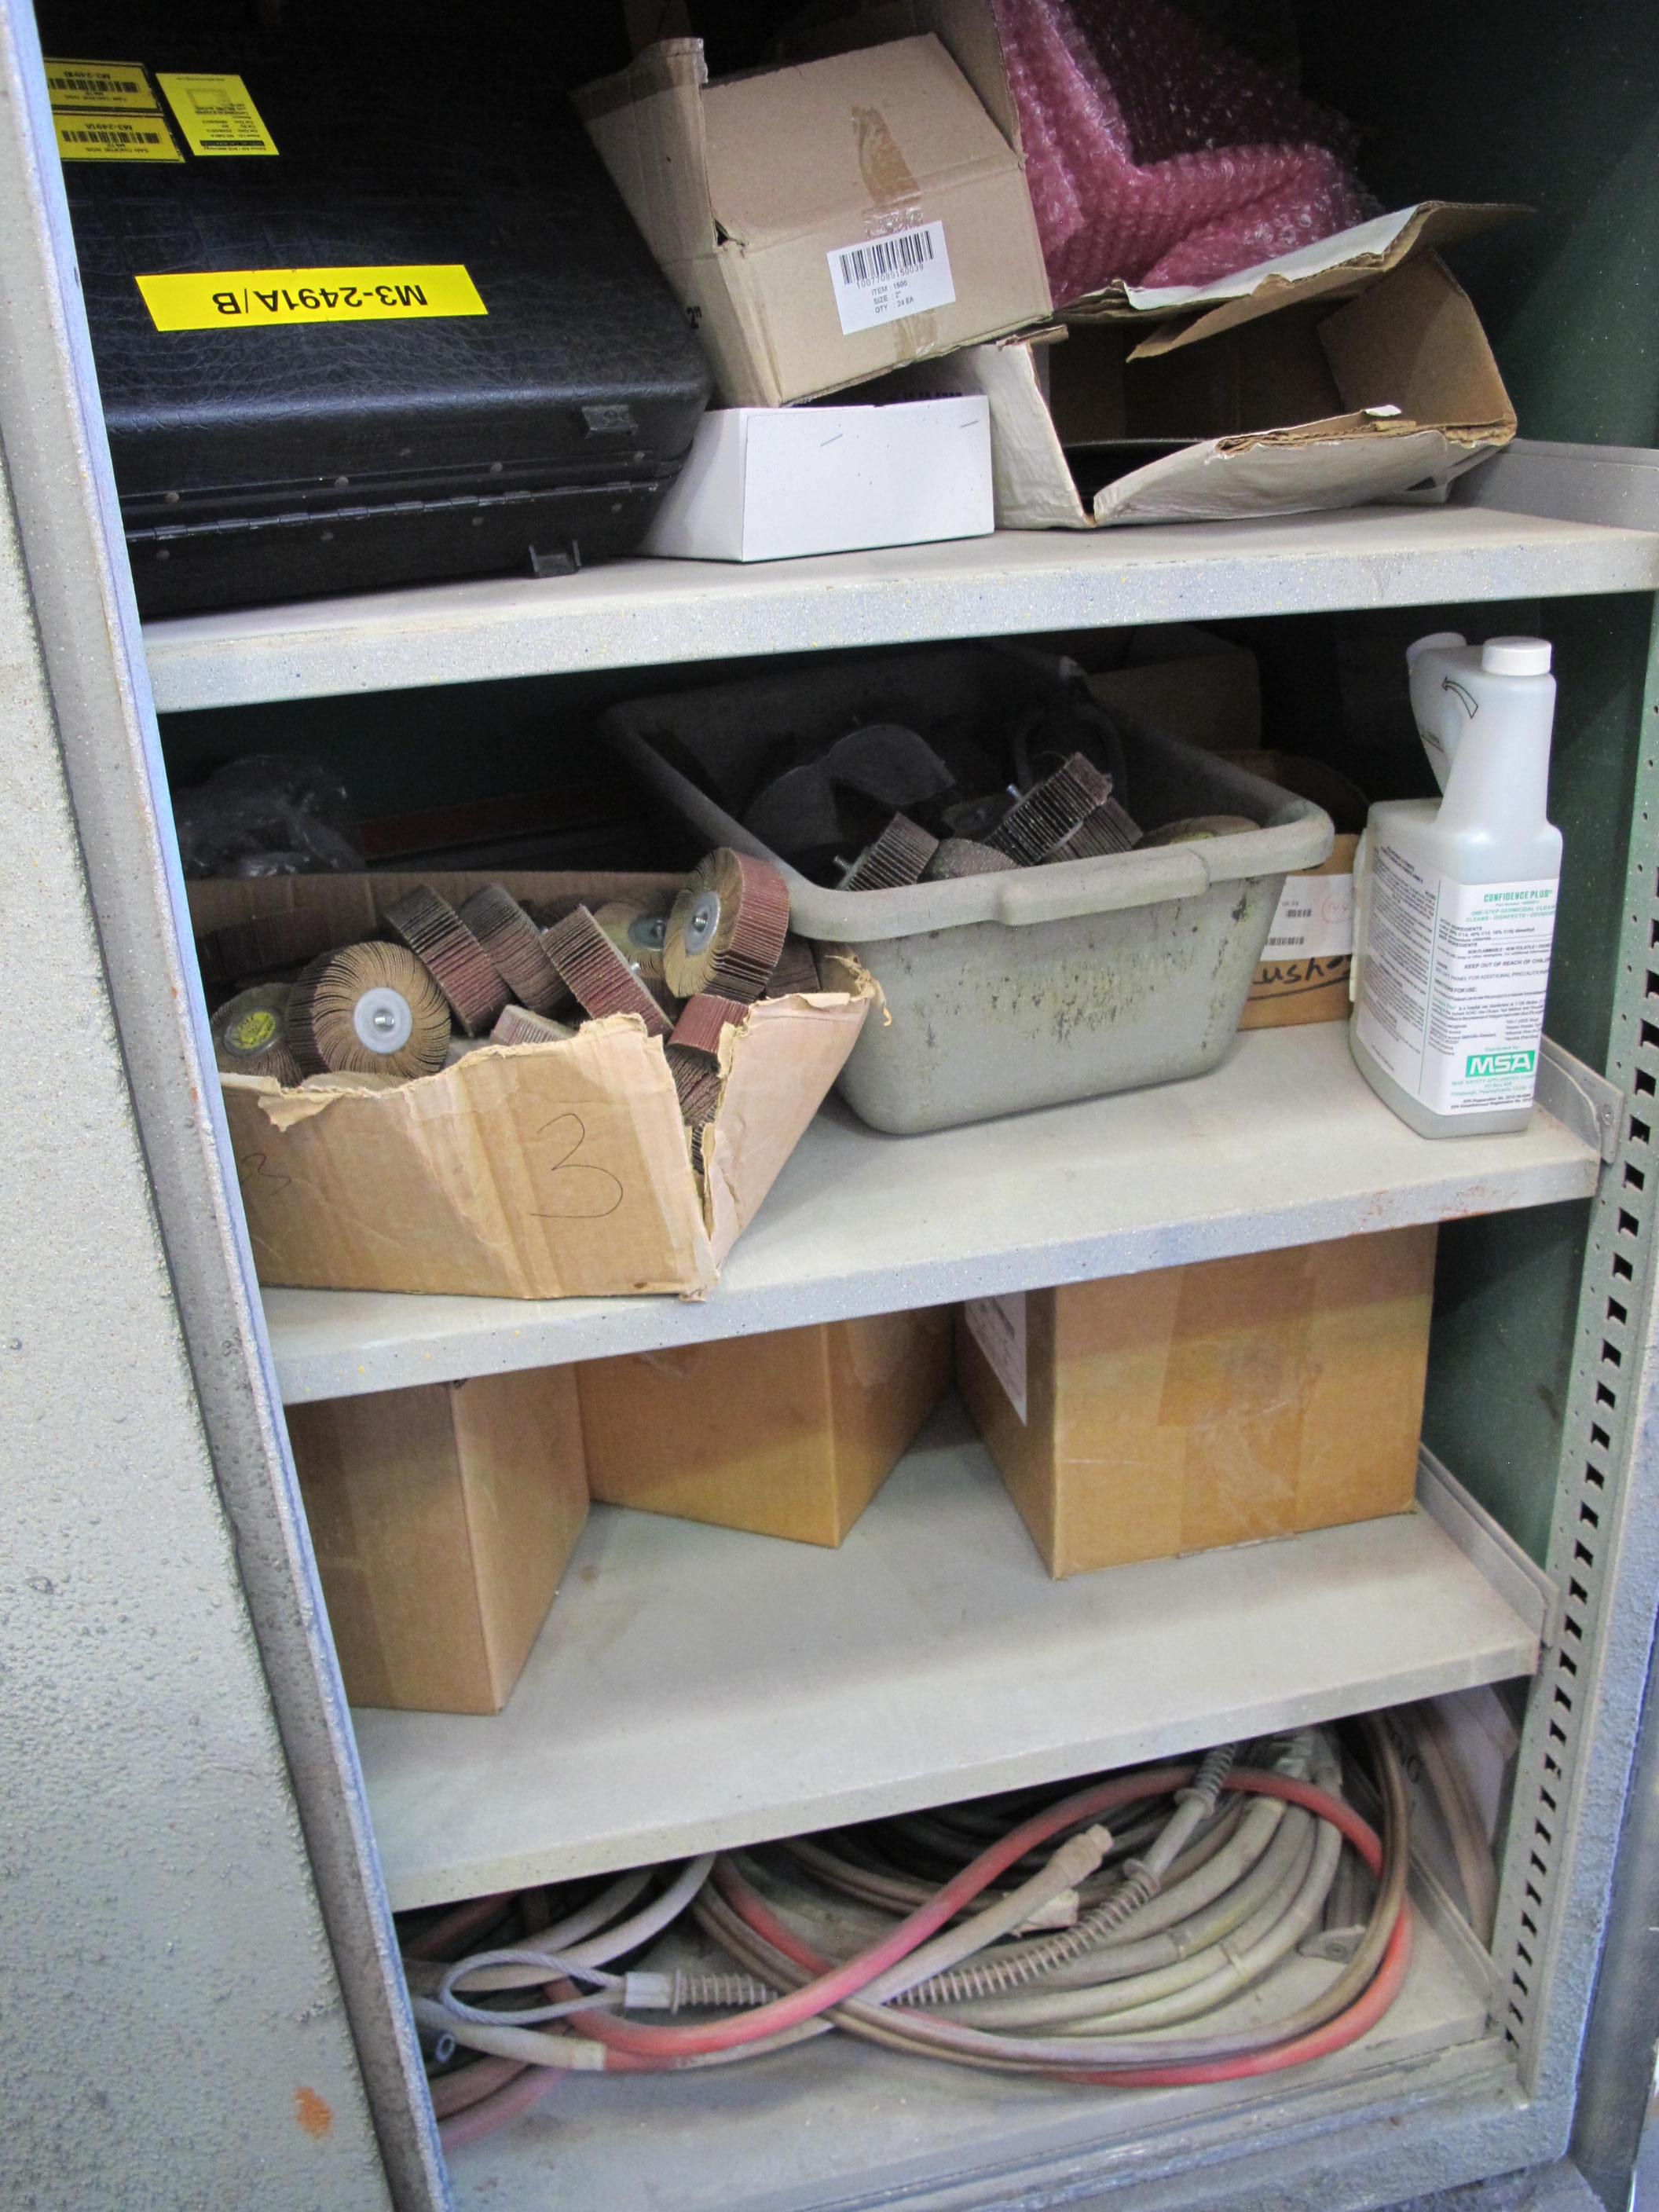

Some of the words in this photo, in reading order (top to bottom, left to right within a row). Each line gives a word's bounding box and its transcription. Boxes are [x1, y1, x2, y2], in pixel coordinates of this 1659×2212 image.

[871, 286, 888, 296] ITEM
[212, 285, 428, 315] M3-2491A/B
[873, 295, 888, 305] SIZE
[875, 305, 888, 313] QTY
[1483, 891, 1529, 903] CONFIDENCE
[1470, 1053, 1532, 1075] MSA
[528, 1112, 624, 1219] 3
